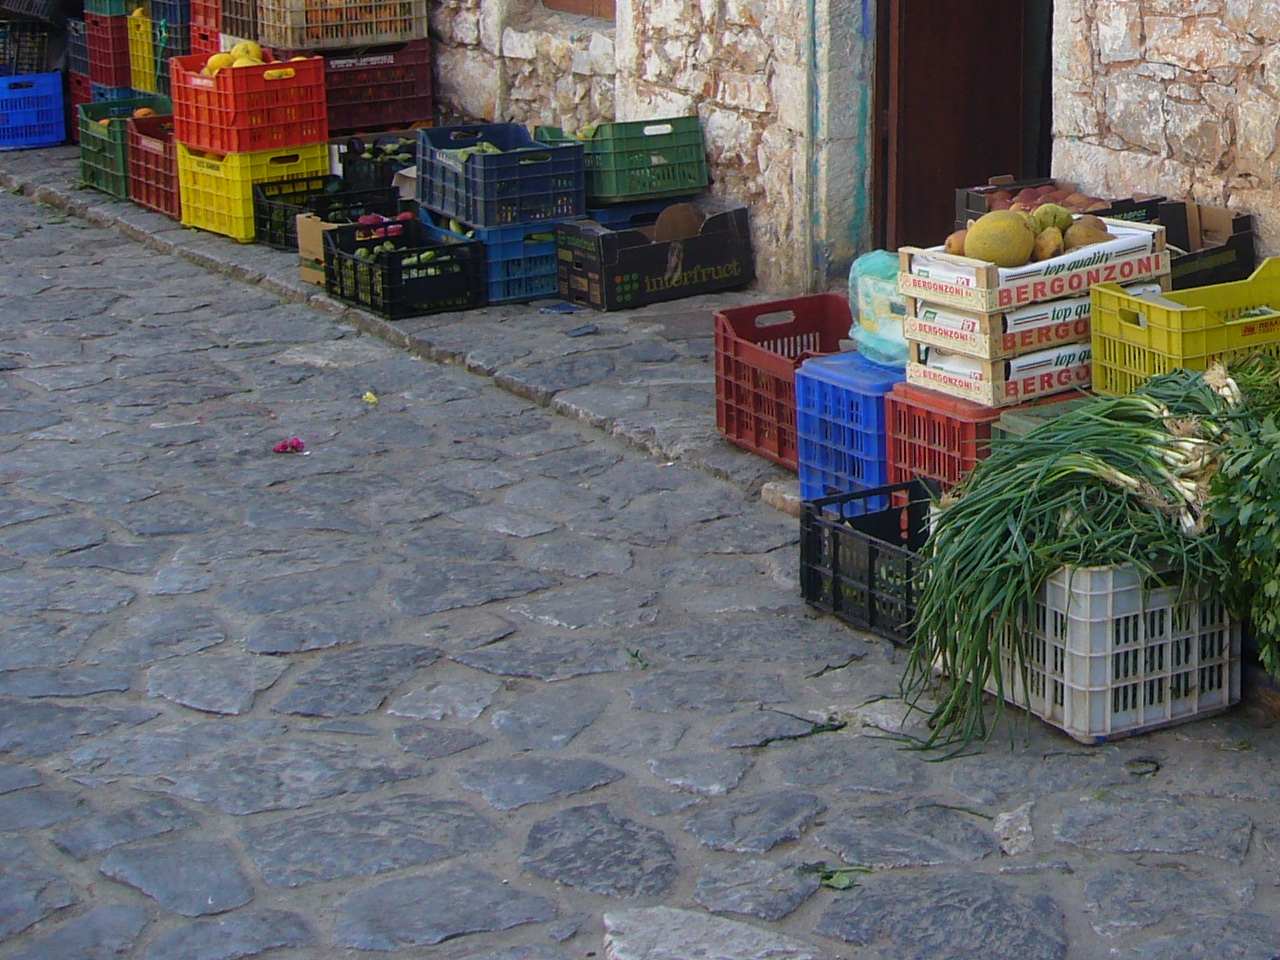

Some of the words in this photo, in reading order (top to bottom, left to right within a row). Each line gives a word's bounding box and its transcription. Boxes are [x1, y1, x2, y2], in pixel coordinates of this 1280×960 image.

[1043, 262, 1066, 277] top
[1067, 250, 1114, 271] quality
[912, 278, 964, 297] BERGONZONI
[999, 254, 1161, 307] BERGONZONI
[1051, 306, 1072, 324] top
[918, 323, 968, 341] BERGONZONI
[1002, 318, 1089, 351] BERGO
[1054, 352, 1075, 367] top
[923, 369, 973, 390] BERGONZONI
[1005, 365, 1090, 397] BERGO
